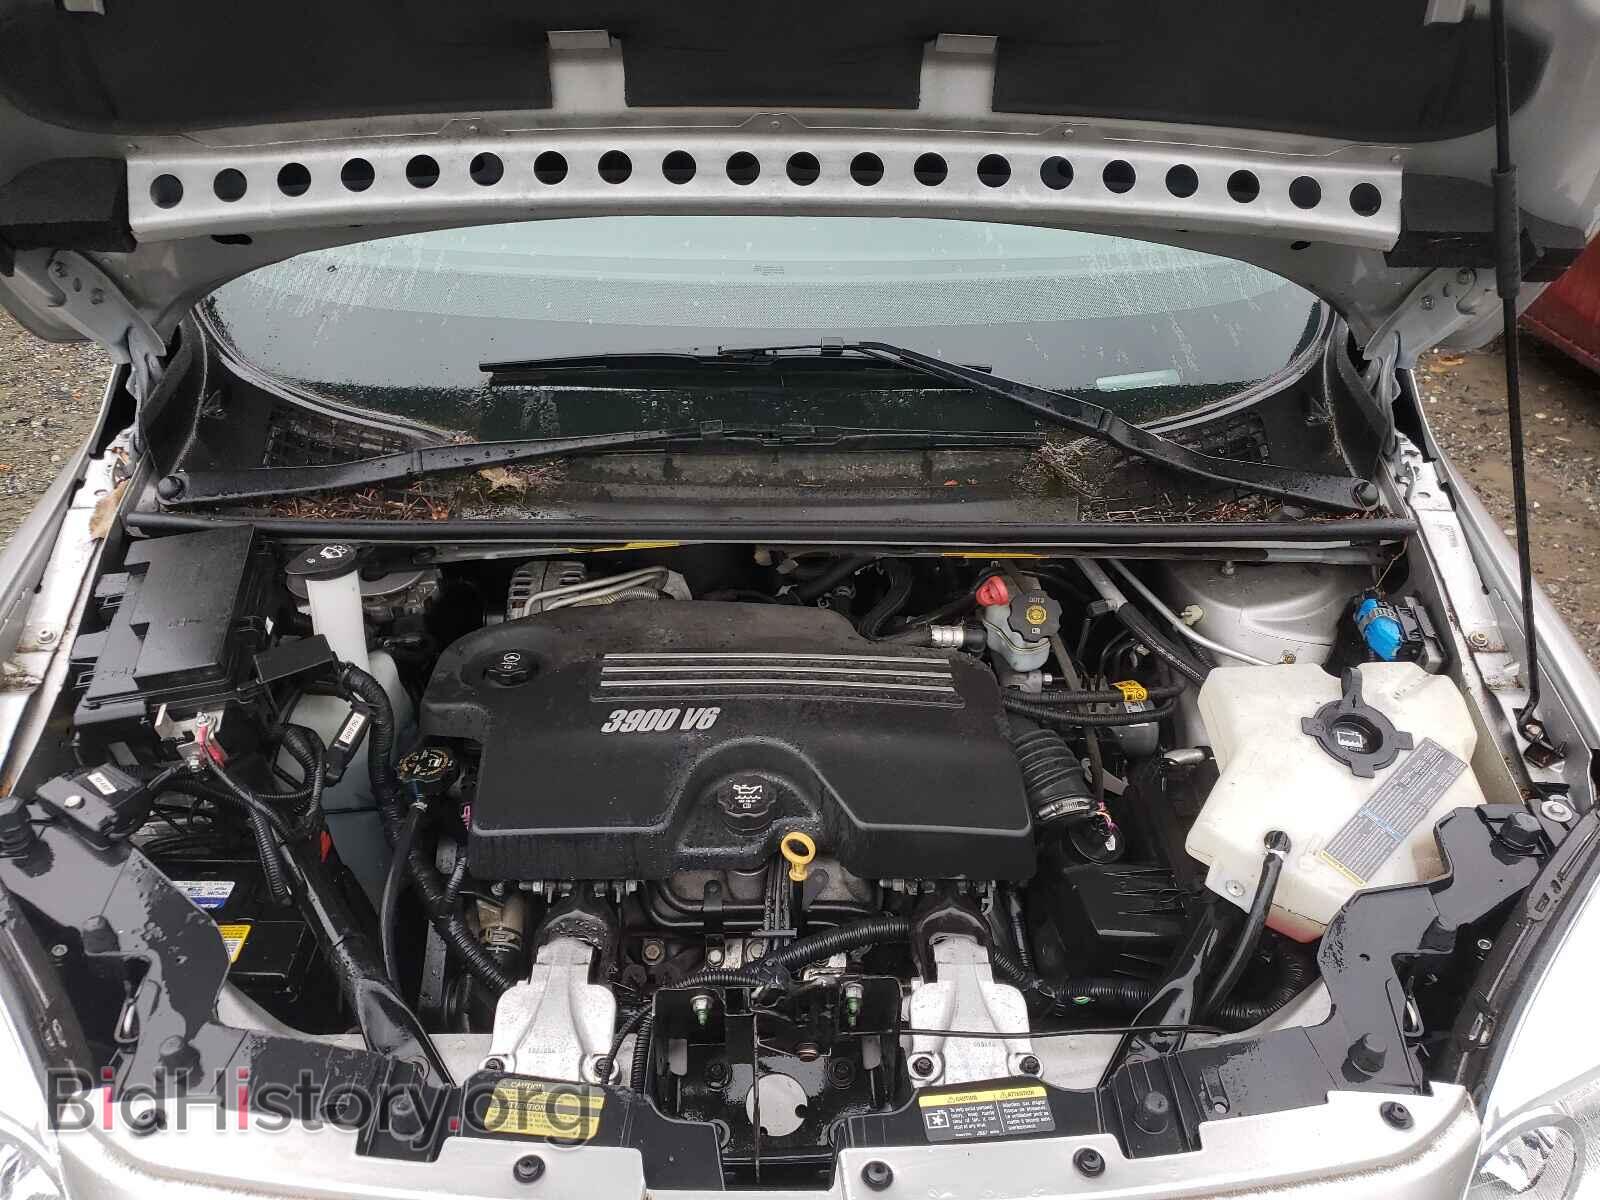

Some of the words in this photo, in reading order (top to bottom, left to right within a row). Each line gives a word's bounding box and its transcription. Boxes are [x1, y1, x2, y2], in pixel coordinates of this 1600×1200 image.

[601, 709, 681, 733] 3900
[679, 707, 721, 730] V6
[510, 1081, 545, 1091] CAUTION
